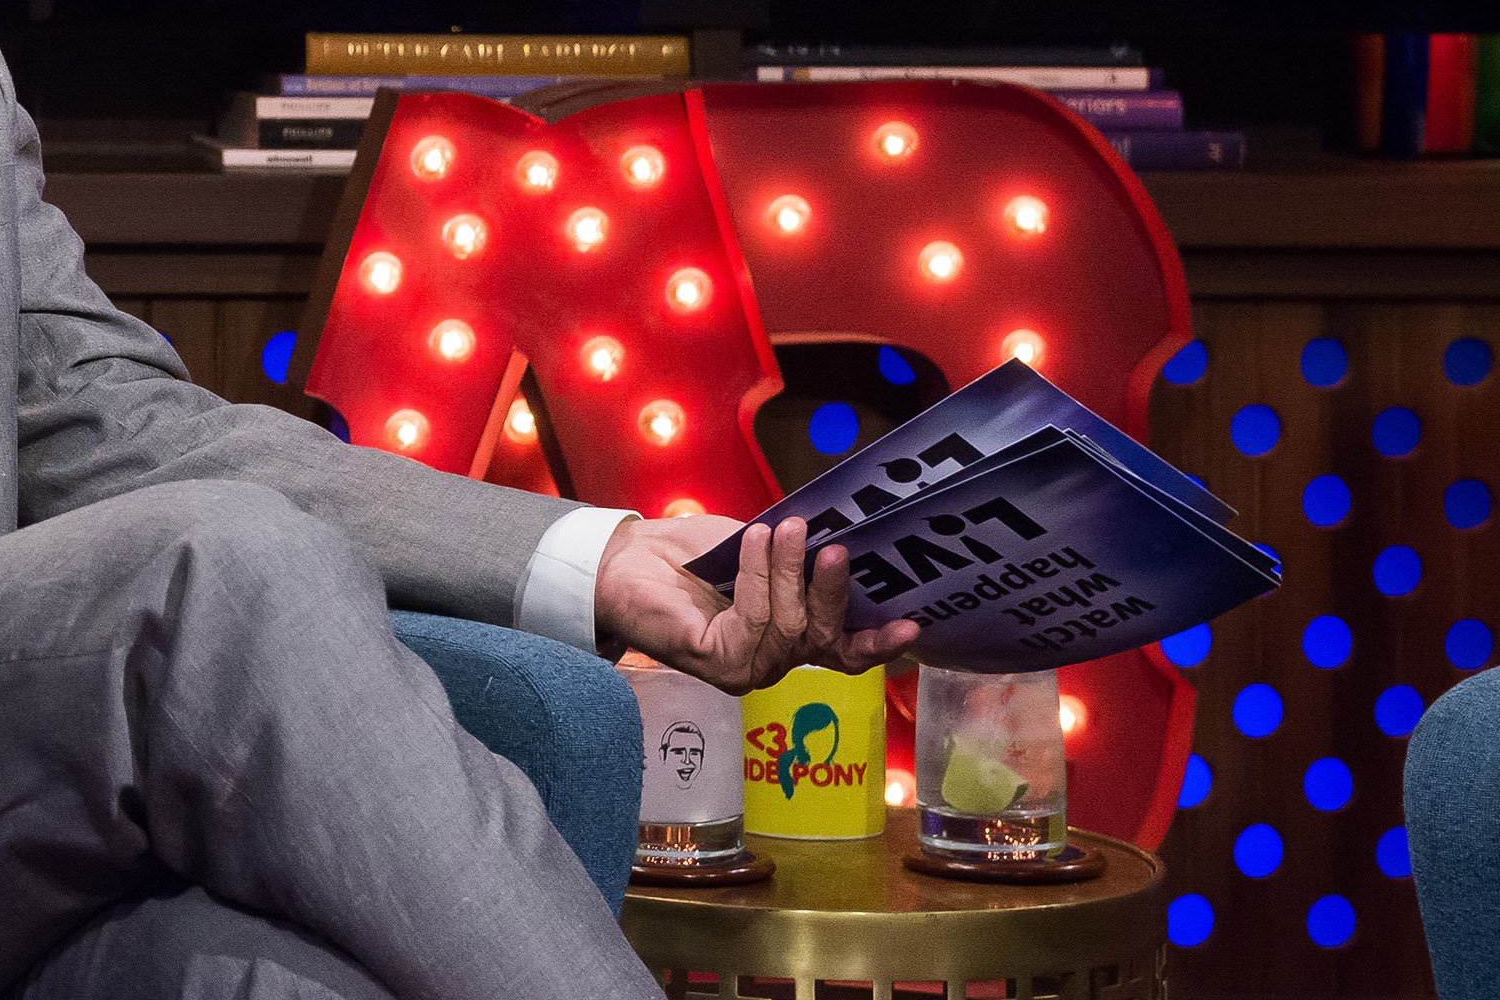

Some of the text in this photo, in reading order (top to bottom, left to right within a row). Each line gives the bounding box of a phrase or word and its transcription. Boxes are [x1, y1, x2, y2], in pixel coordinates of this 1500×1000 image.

[903, 545, 1098, 628] happens
[1002, 572, 1122, 627] what
[1016, 595, 1158, 651] watch
[792, 761, 868, 788] PONY
